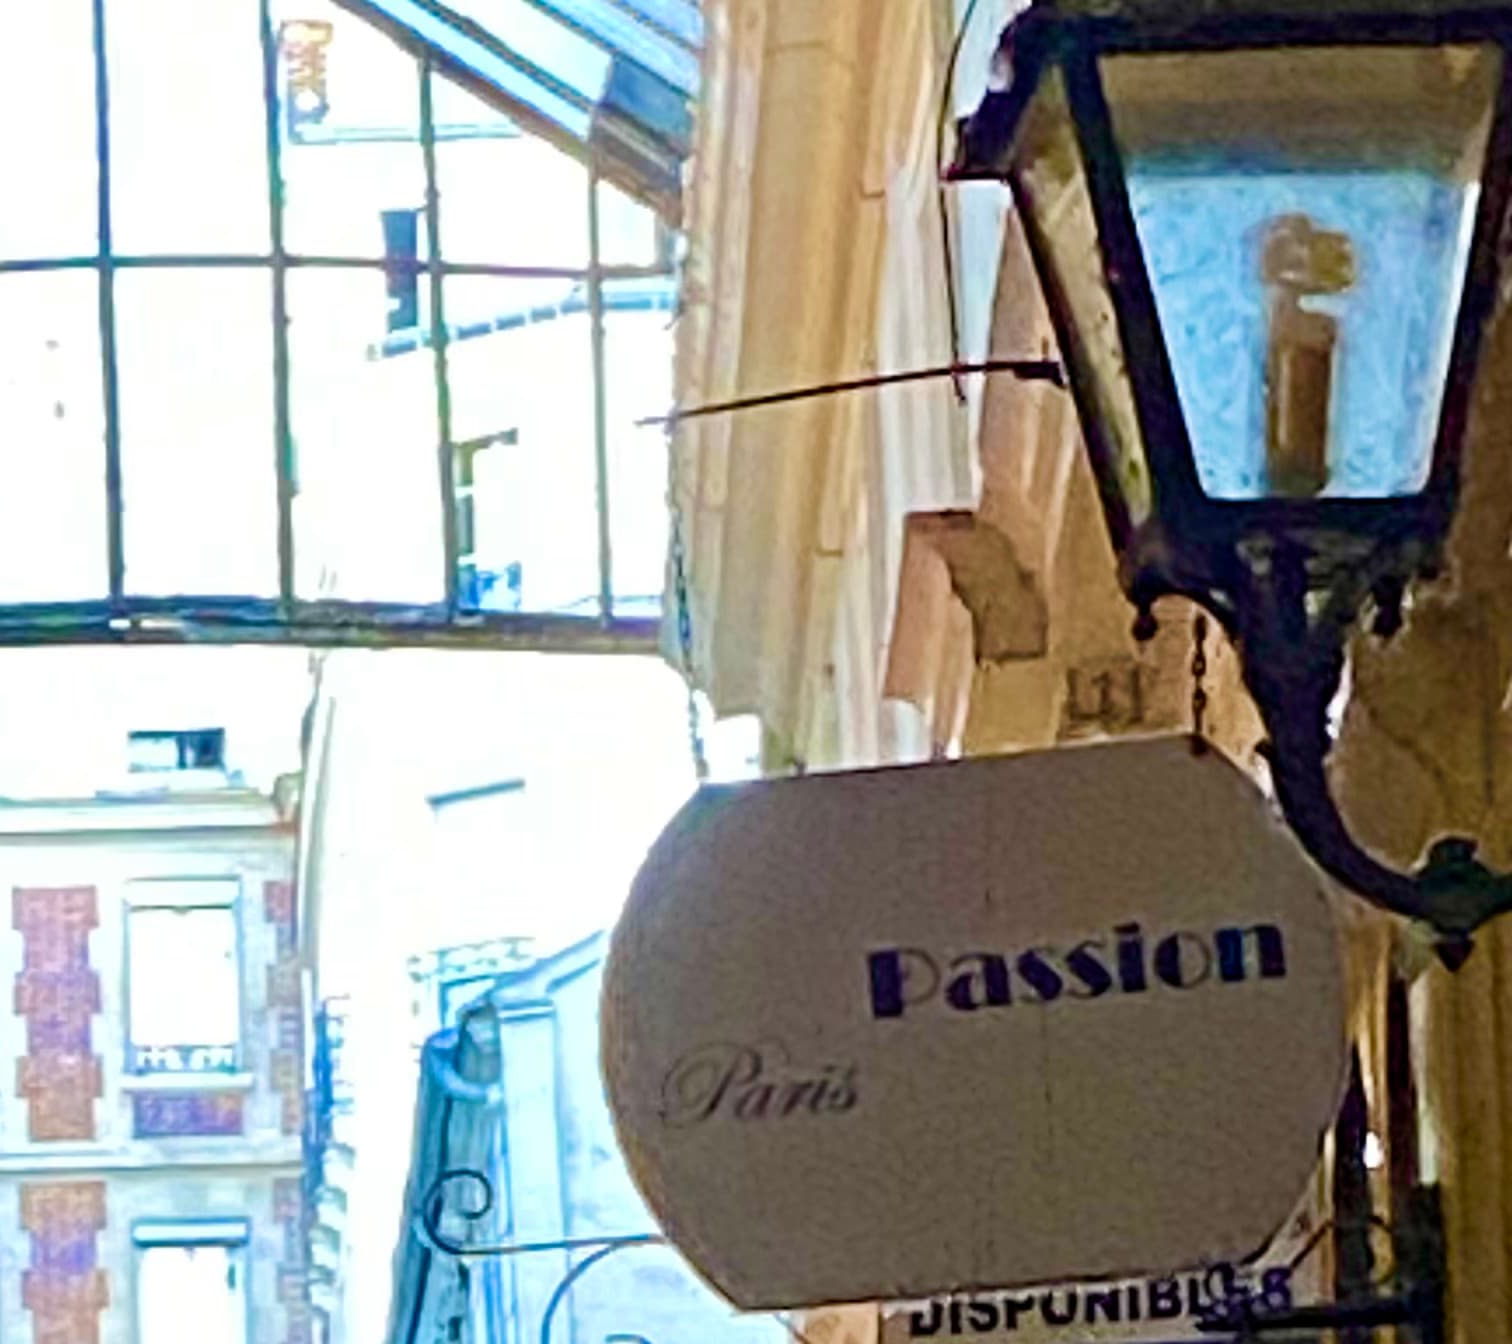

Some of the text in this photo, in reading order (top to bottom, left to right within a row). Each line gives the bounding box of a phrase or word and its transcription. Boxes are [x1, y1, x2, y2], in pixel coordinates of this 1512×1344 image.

[867, 920, 1288, 1018] Passion
[659, 1038, 859, 1126] Paris
[909, 1272, 1230, 1337] DISPONIBL
